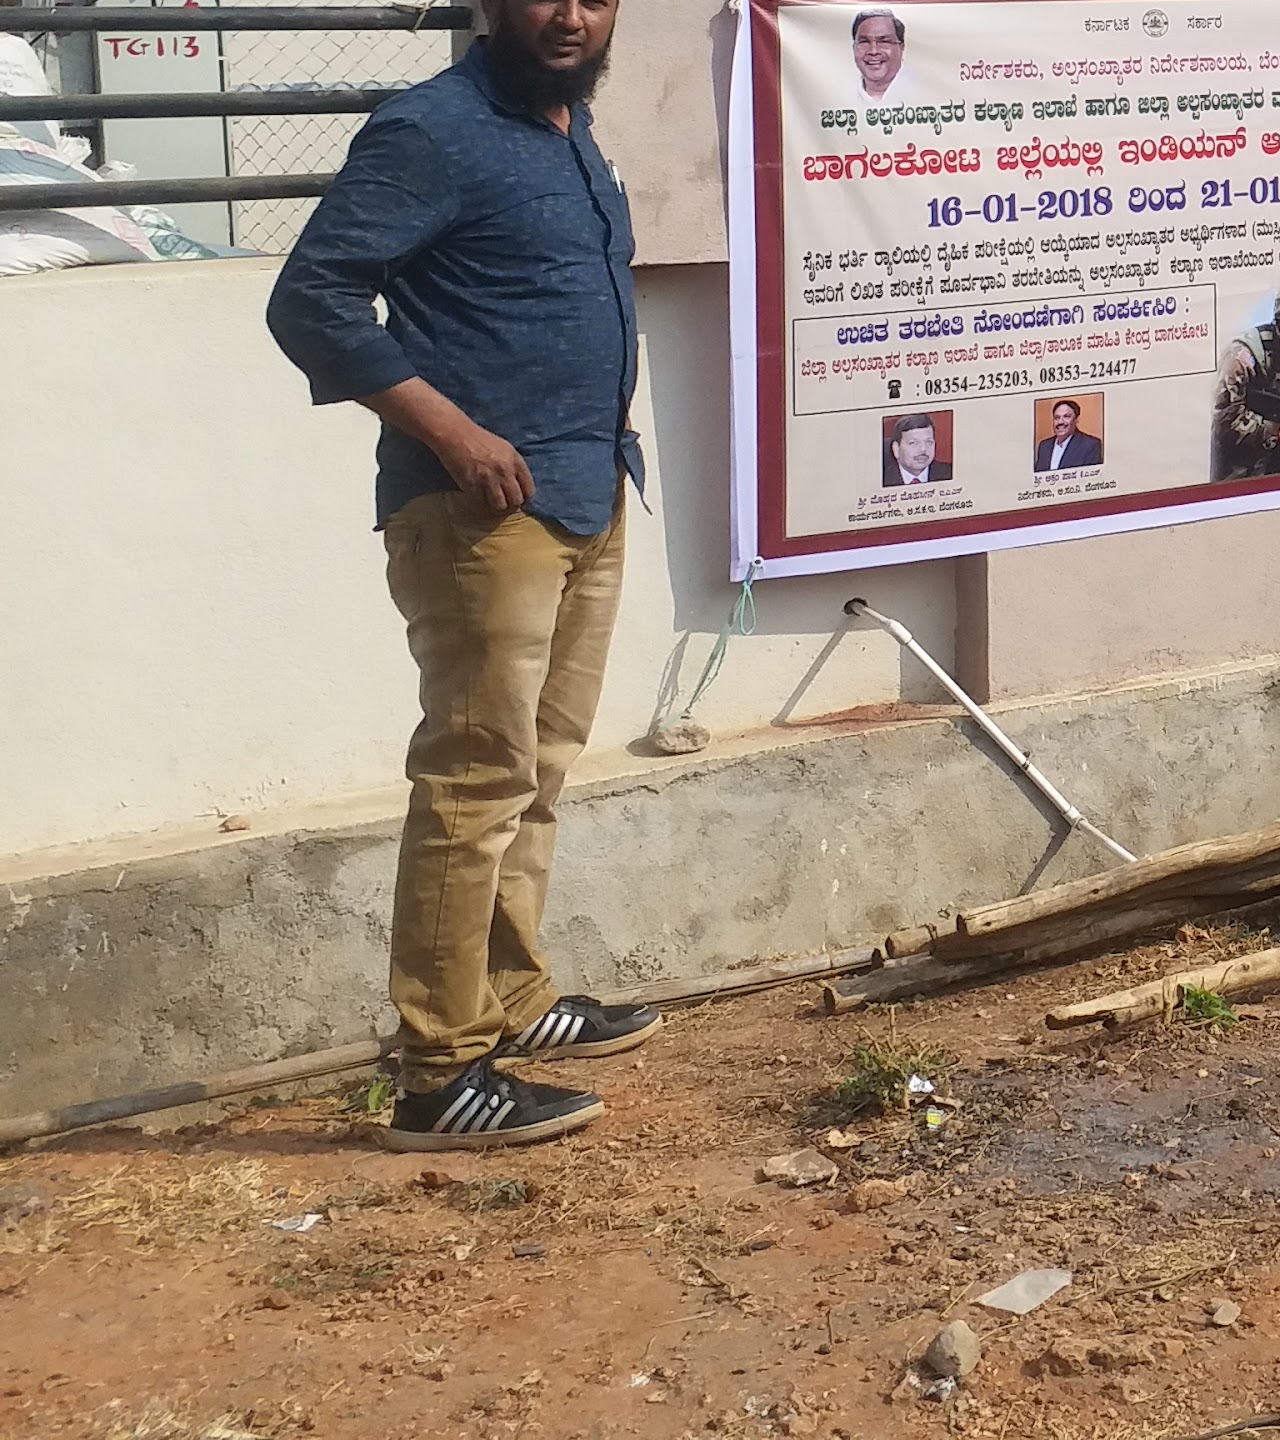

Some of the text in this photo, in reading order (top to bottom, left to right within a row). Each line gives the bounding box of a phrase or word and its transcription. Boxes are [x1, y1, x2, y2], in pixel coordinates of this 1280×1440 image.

[1084, 17, 1130, 32] ಕರ್ನಾಟಕ
[1187, 15, 1222, 29] ಸರ್ಕಾರ
[960, 58, 1043, 80] ನಿರ್ದೇಶಕರು,
[1051, 56, 1143, 85] ಅಲ್ಪಸಂಖ್ಯಾತರ
[1150, 53, 1252, 75] ನಿರ್ದೇಶನಾಲಯ,
[820, 108, 857, 136] ಜಿಲ್ಲಾ
[866, 99, 966, 135] ಅಲ್ಪಸಂಖ್ಯಾತರ
[973, 98, 1024, 132] ಕಲ್ಯಾಣ
[1032, 94, 1078, 120] ಇಲಾಖೆ
[1085, 92, 1130, 117] ಹಾಗೂ
[1138, 94, 1170, 121] ಜಿಲ್ಲಾ
[1177, 87, 1265, 121] ಅಲ್ಪಸಂಖ್ಯಾತರ
[803, 142, 981, 181] ಬಾಗಲಕೋಟ
[996, 135, 1104, 180] ಜಿಲ್ಲೆಯಲ್ಲಿ
[1118, 126, 1247, 165] ಇಂಡಿಯನ್
[927, 186, 1113, 228] 16-01-2018
[1128, 178, 1187, 213] ರಿಂದ
[803, 250, 832, 281] ಸೈನಿಕ
[839, 249, 868, 272] ಭರ್ತಿ
[937, 242, 968, 272] ದೈಹಿಕ
[975, 236, 1035, 265] ಪರೀಕ್ಷೆಯಲ್ಲಿ
[1040, 231, 1100, 262] ಆಯ್ಕೆಯಾದ
[1105, 225, 1175, 255] ಅಲ್ಪಸಂಖ್ಯಾತರ
[1180, 220, 1247, 251] ಅಭ್ಯರ್ಥಿಗಳಾದ
[803, 282, 844, 305] ಇವರಿಗೆ
[850, 279, 884, 302] ಲಿಖಿತ
[890, 275, 934, 304] ಪರೀಕ್ಷೆಗೆ
[940, 271, 1006, 294] ಪೂರ್ವಭಾವಿ
[1011, 264, 1085, 292] ತರಬೇತಿಯನ್ನು
[1089, 257, 1159, 289] ಅಲ್ಪಸಂಖ್ಯಾತರ
[1170, 255, 1203, 284] ಕಲ್ಯಾಣ
[1208, 247, 1274, 273] ಇಲಾಖೆಯಿಂದ
[837, 317, 889, 345] ಉಚಿತ
[898, 313, 964, 340] ತರಬೇತಿ
[973, 303, 1084, 335] ನೋಂದಣಿಗಾಗಿ
[1093, 295, 1177, 322] ಸಂಪರ್ಕಿಸಿರಿ
[801, 359, 827, 383] ಜಿಲ್ಲಾ
[831, 351, 901, 380] ಅಲ್ಪಸಂಖ್ಯಾತರ
[906, 349, 939, 376] ಕಲ್ಯಾಣ
[944, 343, 979, 365] ಇಲಾಖೆ
[984, 342, 1015, 360] ಹಾಗೂ
[1086, 331, 1121, 349] ಮಾಹಿತಿ
[1125, 327, 1151, 350] ಕೇಂದ್ರ
[1154, 323, 1209, 342] ಬಾಗಲಕೋಟ
[1039, 358, 1137, 384] 08353-224477
